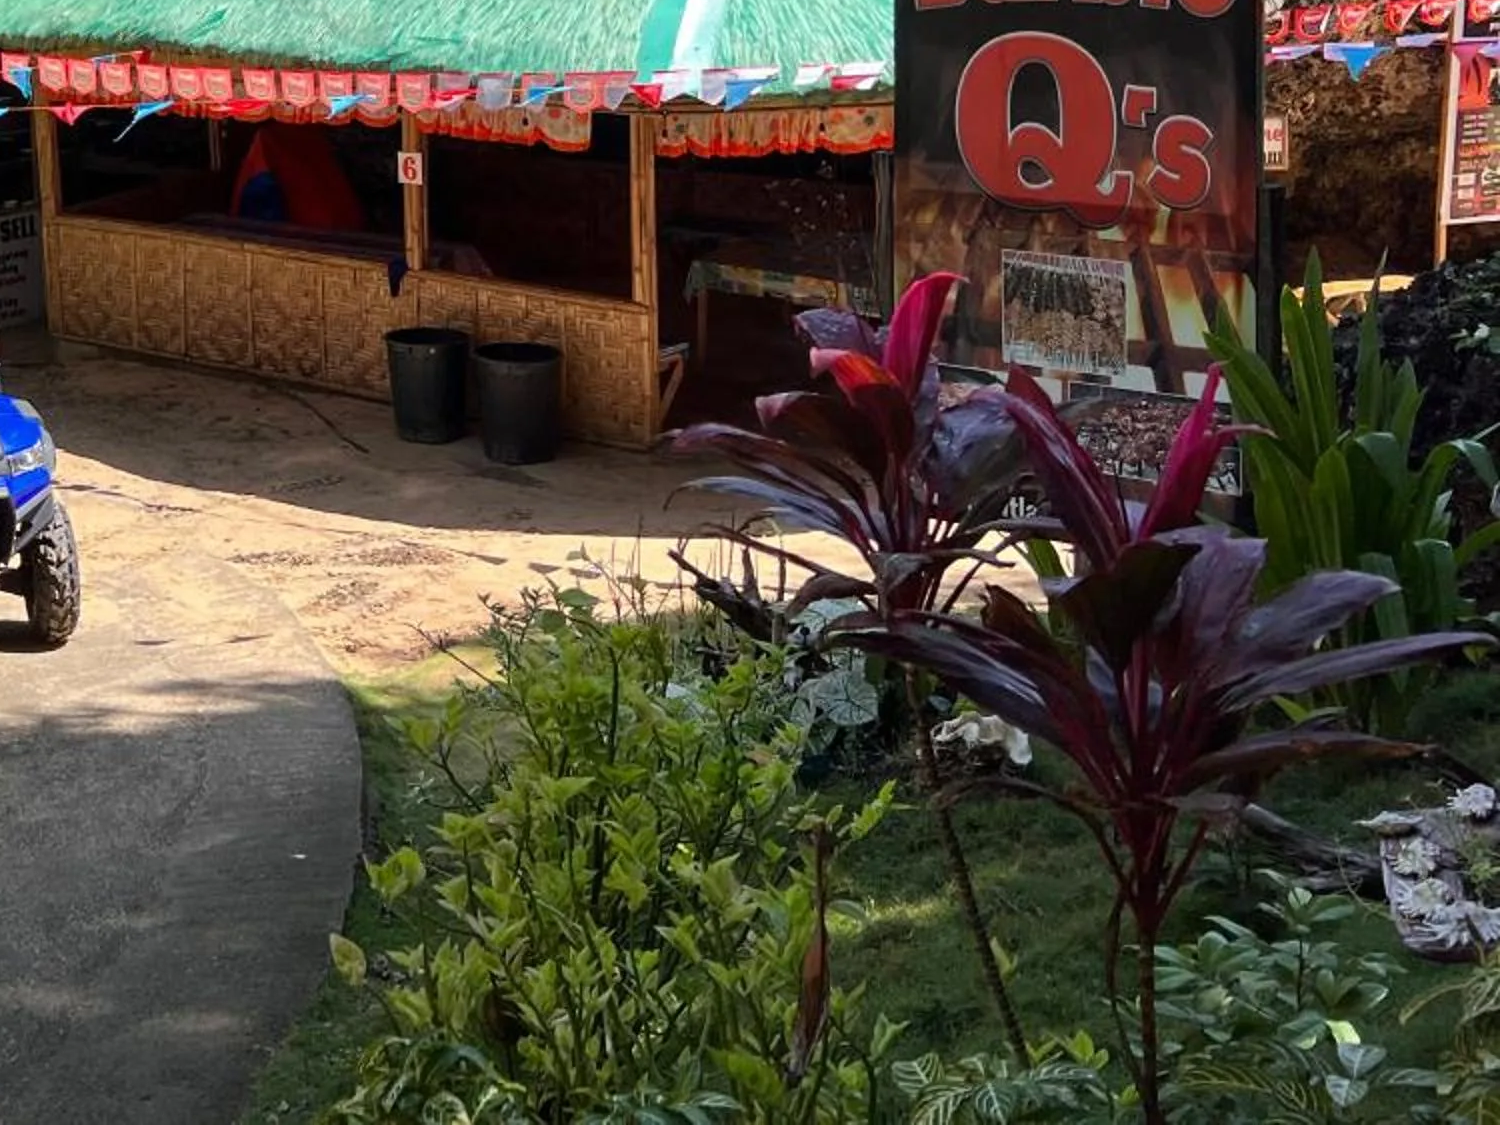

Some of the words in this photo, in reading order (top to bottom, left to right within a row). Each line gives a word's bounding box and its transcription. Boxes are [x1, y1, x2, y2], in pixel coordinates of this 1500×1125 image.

[955, 30, 1214, 228] Q's
[403, 156, 417, 181] 6
[0, 214, 38, 242] SELL
